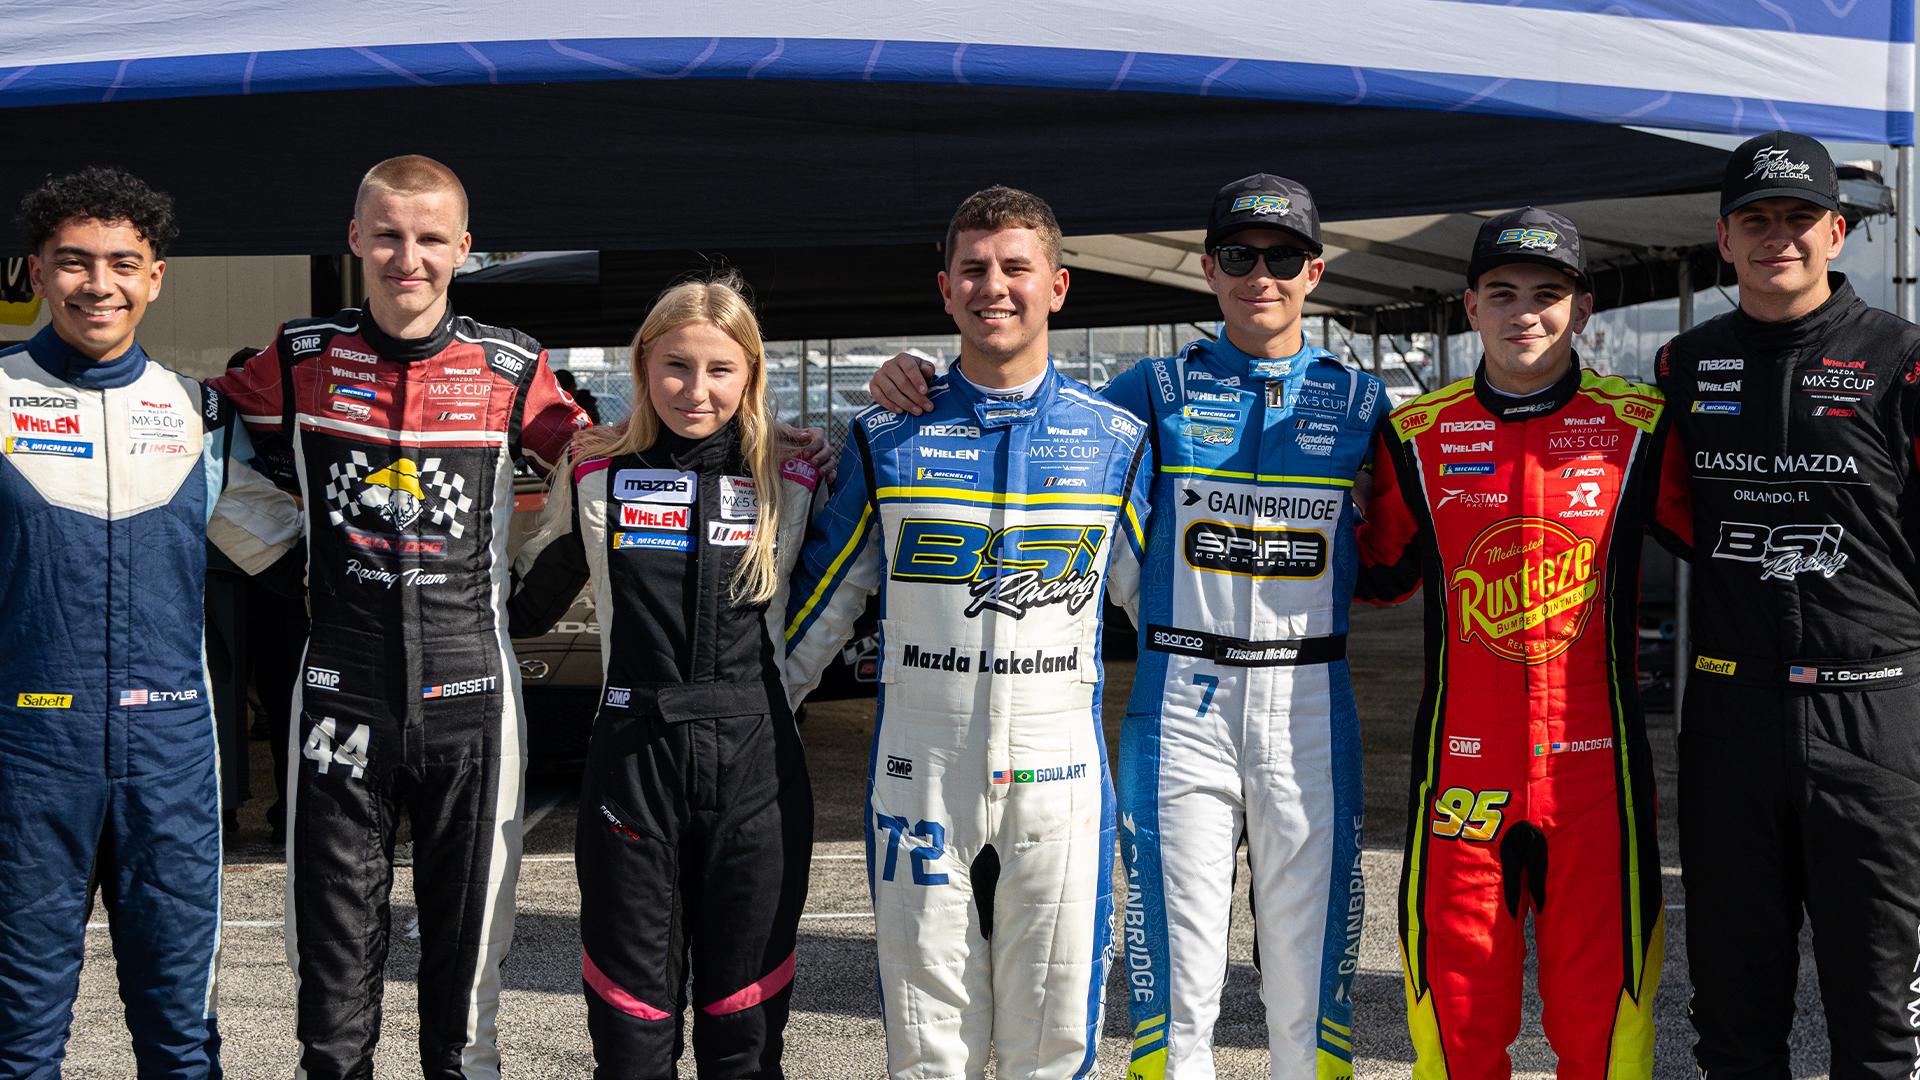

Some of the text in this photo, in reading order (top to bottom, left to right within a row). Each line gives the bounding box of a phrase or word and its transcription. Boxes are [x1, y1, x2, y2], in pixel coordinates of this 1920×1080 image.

[292, 337, 321, 352] OMP
[494, 352, 523, 373] OMP
[1823, 357, 1866, 369] WHELEN
[331, 366, 376, 383] WHELEN
[444, 367, 481, 375] WHELEN
[1152, 360, 1176, 402] sparco
[1303, 378, 1336, 390] WHELEN
[1697, 380, 1742, 392] WHELEN
[1802, 375, 1875, 390] MX-5 CUP
[429, 384, 491, 396] MX-5 CUP
[1186, 389, 1240, 402] WHELEN
[1289, 394, 1347, 410] MX-5 CUP
[1359, 378, 1379, 422] sparco
[1623, 403, 1655, 419] OMP
[1826, 408, 1857, 417] IMSA
[12, 411, 80, 435] WHELEN
[132, 416, 184, 428] MX-5 CUP
[867, 412, 897, 427] OMP
[1111, 418, 1138, 436] OMP
[1308, 422, 1339, 432] IMSA
[1401, 413, 1428, 430] OMP
[1564, 416, 1606, 426] WHELEN
[1047, 426, 1088, 436] WHELEN
[1295, 433, 1336, 446] Hendrick
[1549, 435, 1619, 449] MX-5 CUP
[31, 443, 86, 454] MICHELIN
[920, 446, 979, 460] WHELEN
[1030, 445, 1100, 458] MX-5 CUP
[1301, 443, 1332, 453] Cars.com
[1440, 441, 1493, 454] WHELEN
[785, 460, 816, 477] OMP
[1695, 451, 1859, 474] CLASSIC MAZDA
[934, 471, 973, 480] MICHELIN
[1575, 468, 1606, 477] IMSA
[1056, 478, 1087, 487] IMSA
[722, 496, 750, 508] MX-5
[1733, 489, 1810, 503] ORLANDO, FL
[1208, 490, 1338, 521] GAINBRIDGE
[624, 506, 688, 528] WHELEN
[1559, 509, 1605, 518] REMSTAR
[636, 537, 689, 547] MICHELIN
[1196, 532, 1319, 559] SPIRE
[1484, 533, 1545, 566] Medicated
[1760, 551, 1849, 581] Racing
[346, 559, 448, 590] Racing Team
[964, 569, 1099, 620] Racing
[1154, 631, 1204, 647] sparco
[903, 644, 1078, 675] Mazda Lakeland
[1225, 647, 1298, 661] Tristan McKee
[1698, 658, 1732, 674] Sabelt
[307, 670, 340, 687] OMP
[1821, 667, 1903, 681] T. Gonzalez
[443, 676, 497, 697] GOSSETT
[23, 694, 66, 707] Sabelt
[608, 690, 631, 705] OMP
[1192, 673, 1220, 718] 7
[303, 717, 370, 779] 44
[1450, 740, 1481, 754] OMP
[1571, 738, 1613, 752] DACOSTA
[887, 759, 912, 776] OMP
[1036, 764, 1087, 782] GOULART
[1432, 786, 1510, 841] 95
[876, 812, 950, 886] 72
